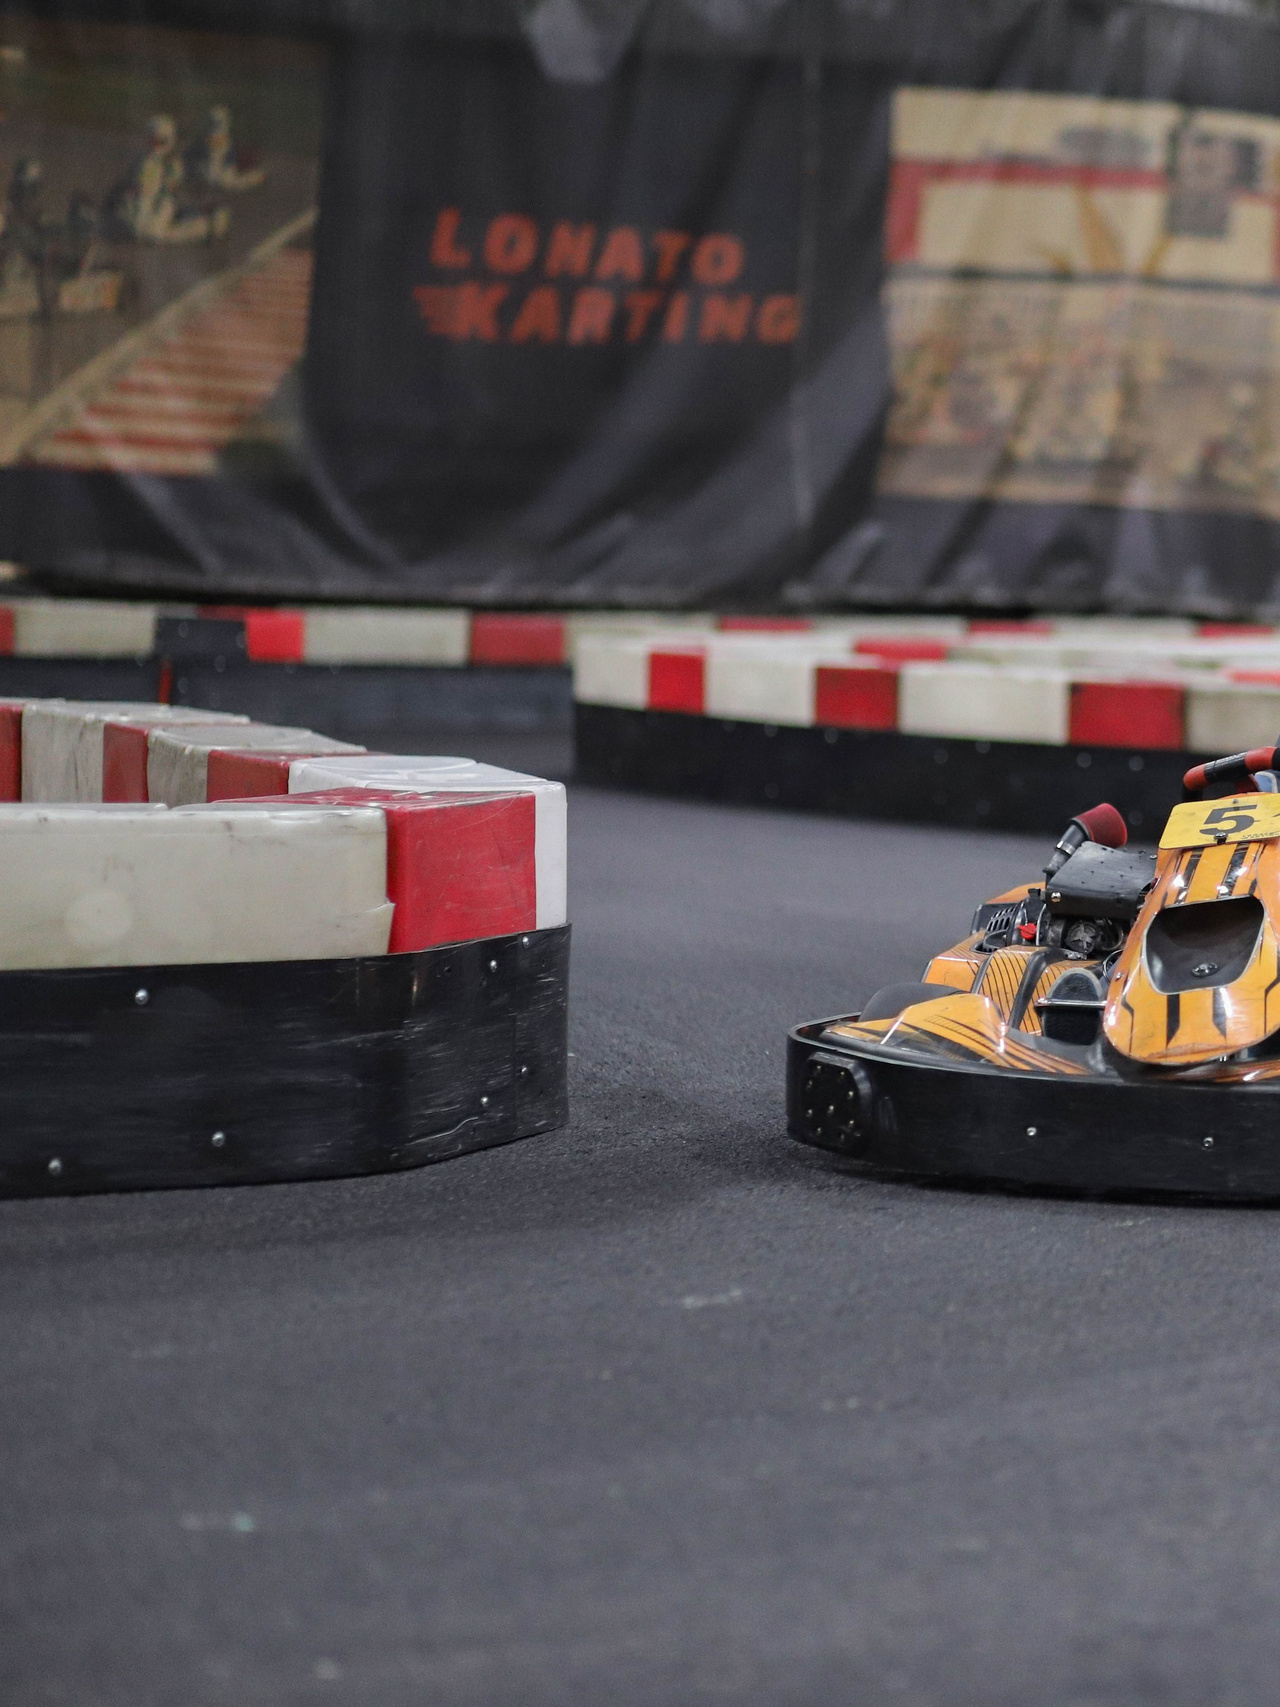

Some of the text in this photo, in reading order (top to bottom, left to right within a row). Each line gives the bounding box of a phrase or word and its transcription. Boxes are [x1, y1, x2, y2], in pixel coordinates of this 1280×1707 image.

[430, 206, 746, 286] LONATO
[445, 281, 801, 345] KARTING
[1199, 804, 1258, 836] 5
